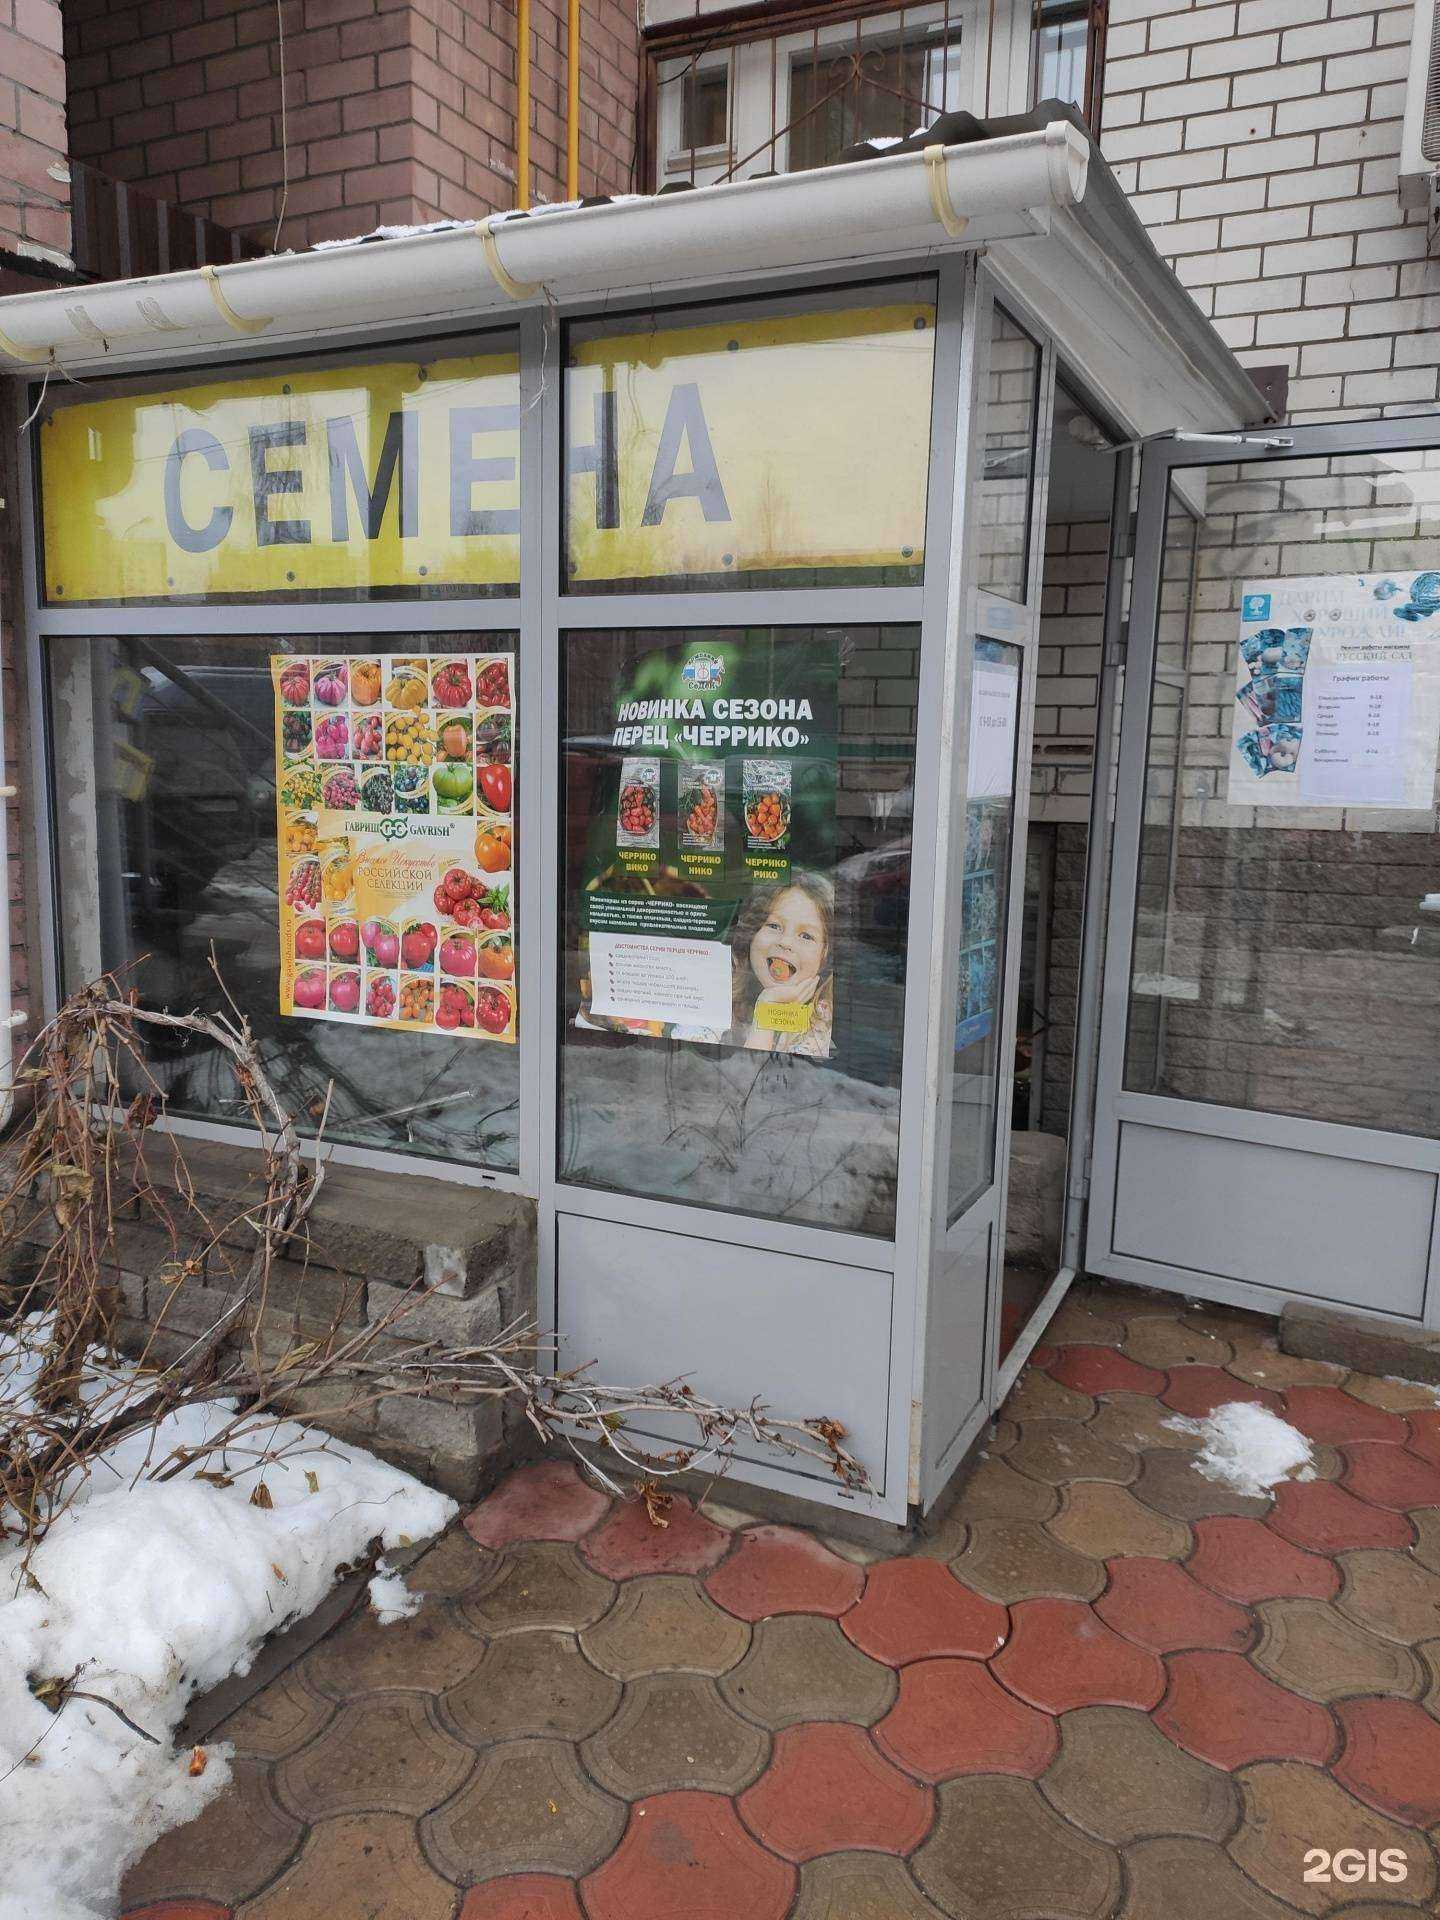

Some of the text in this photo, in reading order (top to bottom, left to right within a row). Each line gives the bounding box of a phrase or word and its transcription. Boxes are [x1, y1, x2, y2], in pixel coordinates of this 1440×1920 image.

[163, 382, 732, 555] СЕМЕНА
[1332, 675, 1360, 683] График
[618, 698, 813, 722] НОВИНКА СЕЗОНА
[612, 725, 809, 749] ПЕРЕЦ «ЧЕРРИКО»
[345, 821, 380, 833] ГАВРИШ
[618, 851, 657, 862] ЧЕРРИКО
[680, 854, 721, 865] ЧЕРРИКО
[625, 863, 649, 872] ВИКО
[745, 858, 787, 868] ЧЕРРИКО
[358, 866, 432, 880] РОССИЙСКОЙ
[688, 866, 713, 876] НИКО
[753, 870, 778, 879] РИКО
[367, 878, 423, 890] СЕЛЕКЦИИ
[767, 1008, 799, 1018] НОВИНКА
